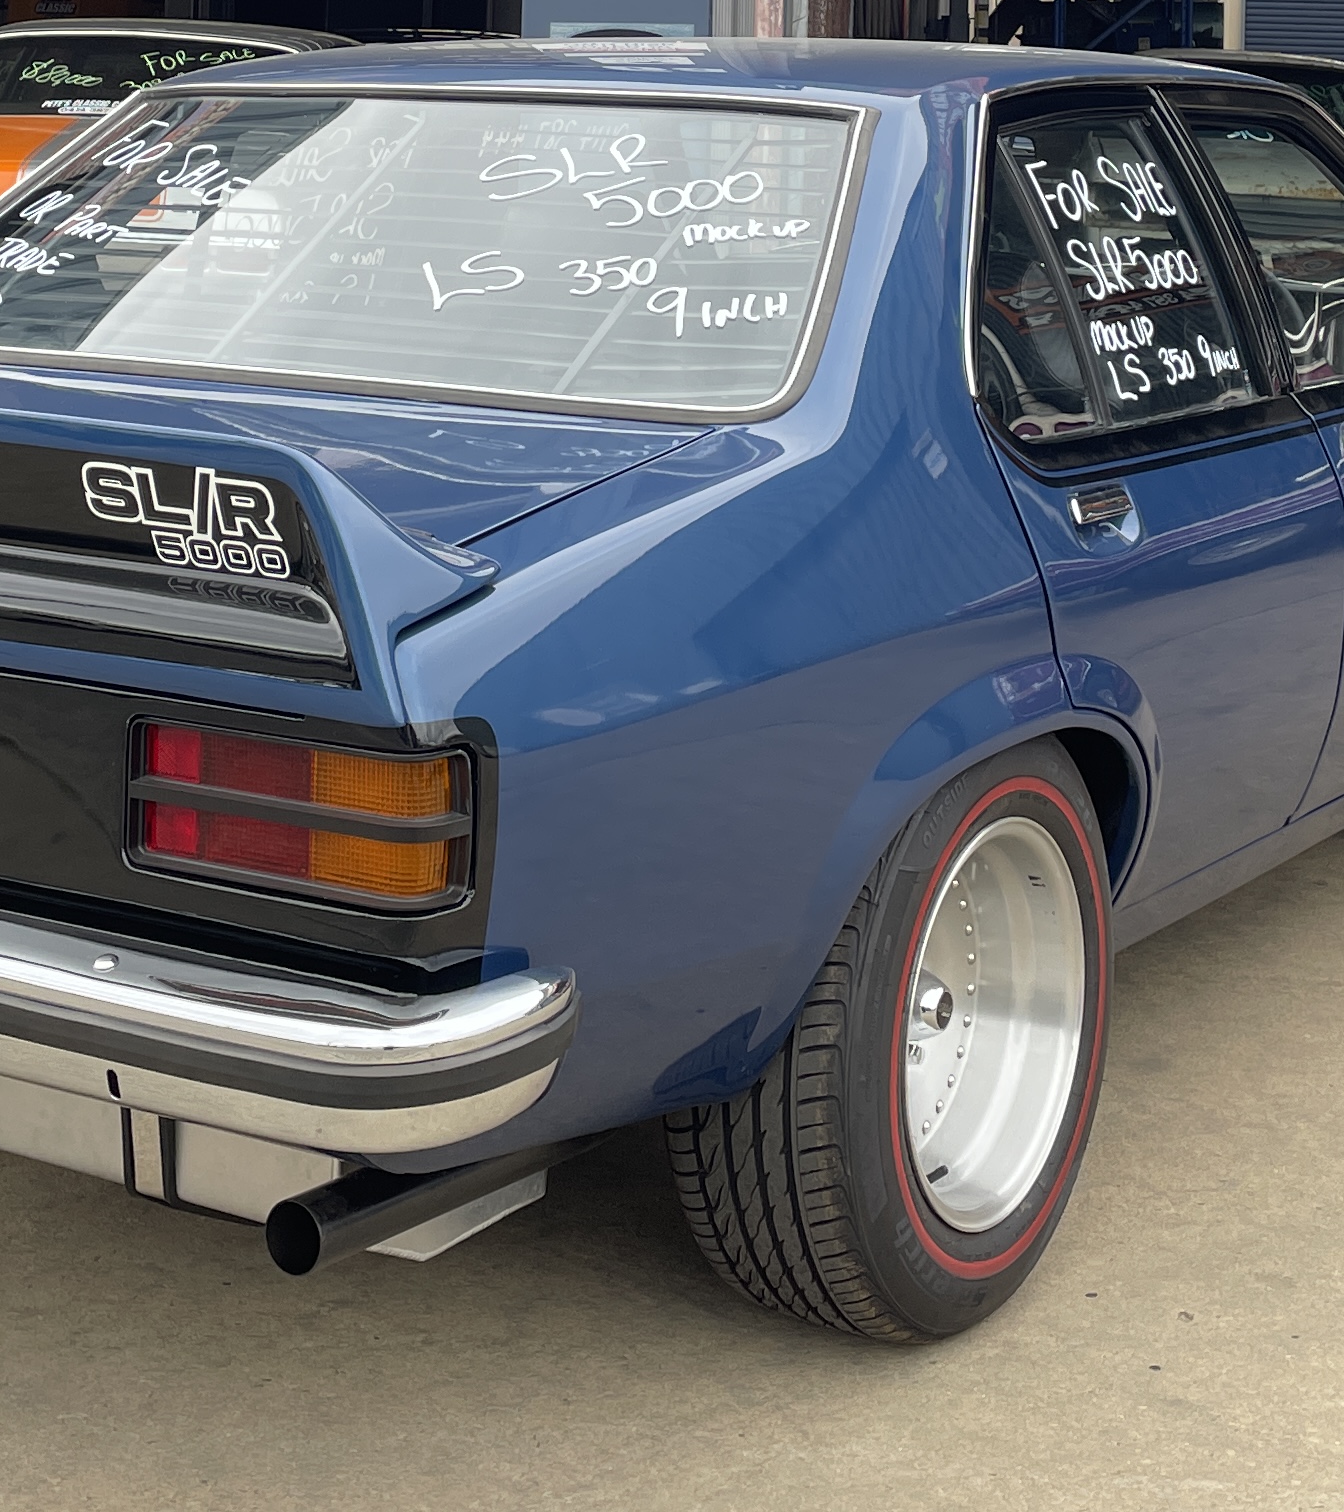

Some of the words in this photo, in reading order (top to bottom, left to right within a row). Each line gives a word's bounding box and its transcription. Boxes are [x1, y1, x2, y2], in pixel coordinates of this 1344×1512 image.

[36, 3, 76, 13] CLASSIC
[140, 51, 197, 76] FOR
[91, 118, 171, 175] FOR
[156, 143, 254, 208] SALE
[479, 133, 668, 200] SLR
[1025, 160, 1099, 229] FOR
[1096, 155, 1176, 223] SALE
[18, 190, 69, 224] OR
[53, 204, 131, 245] PART
[583, 171, 764, 228] 5000
[423, 250, 525, 311] LS
[559, 255, 658, 296] 350
[645, 286, 689, 339] 9
[1107, 356, 1151, 402] LS
[1158, 351, 1196, 386] 350
[1197, 335, 1213, 378] 9
[81, 461, 283, 542] SL/R
[150, 530, 290, 580] 5000
